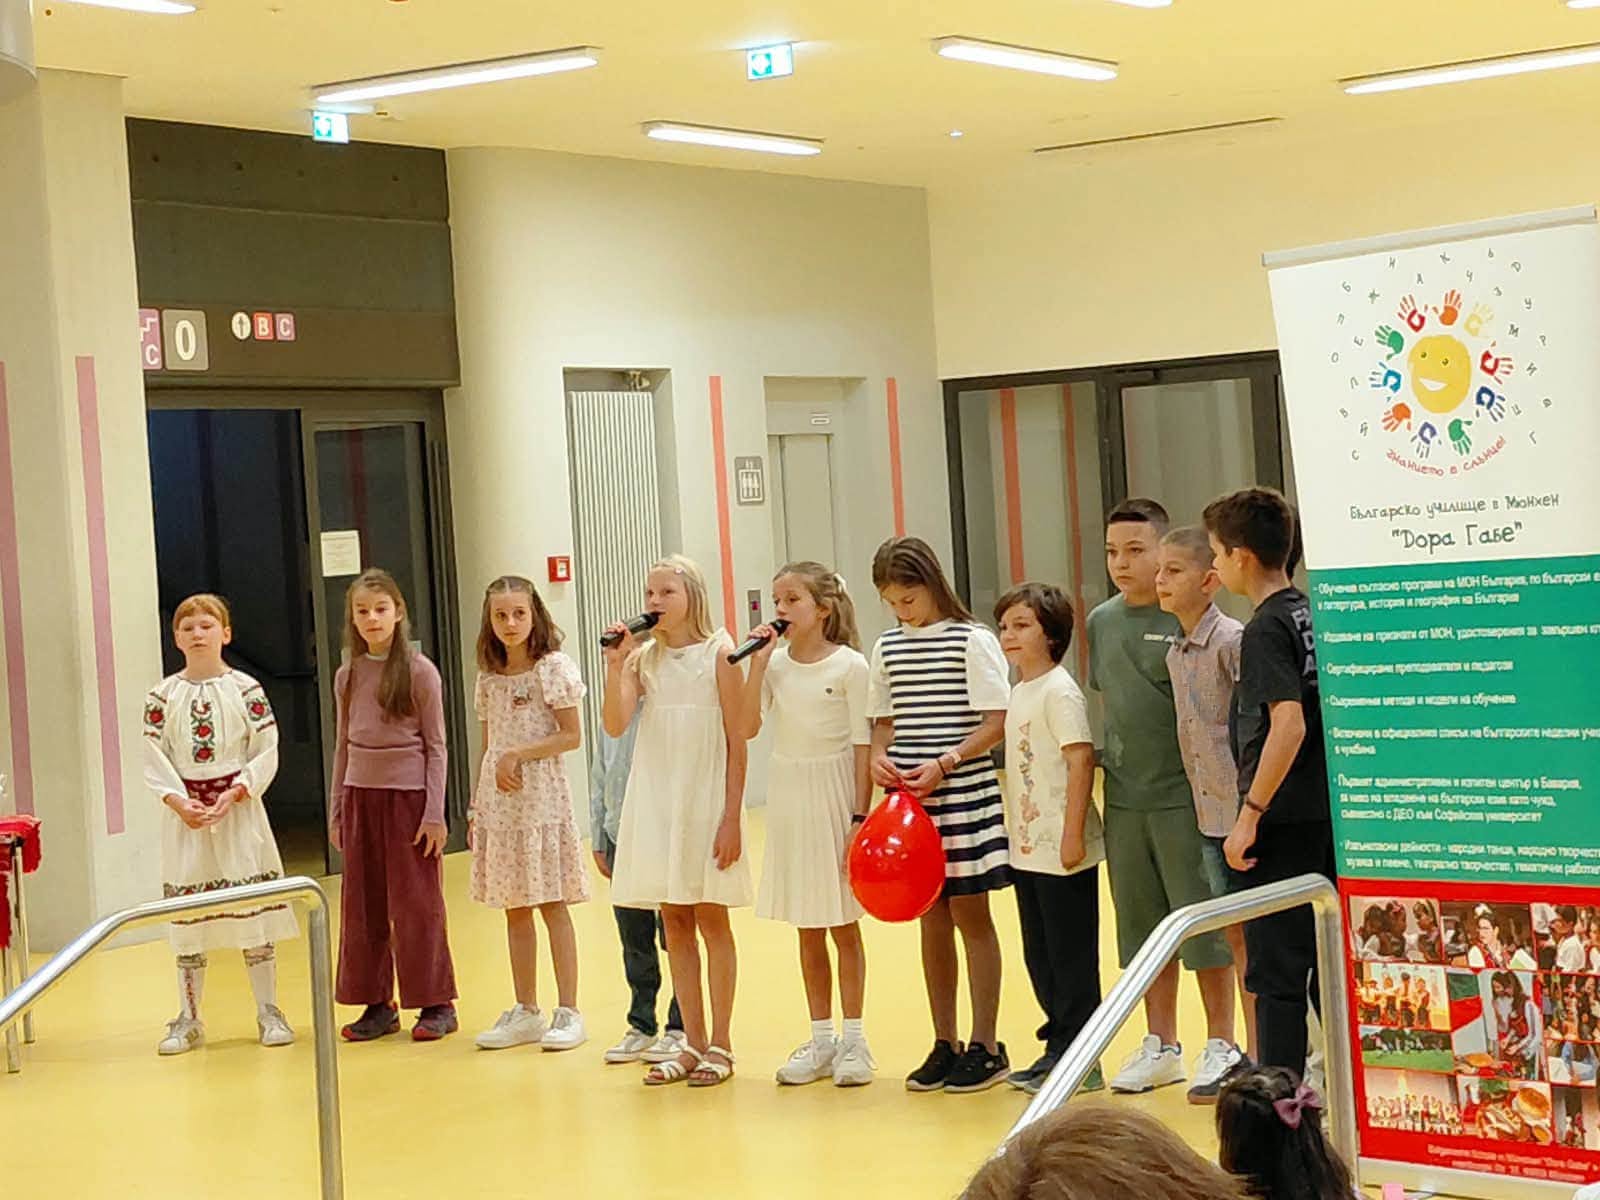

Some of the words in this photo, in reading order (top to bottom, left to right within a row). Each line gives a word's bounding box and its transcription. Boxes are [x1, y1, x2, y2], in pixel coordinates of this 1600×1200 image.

[258, 317, 269, 336] B
[279, 318, 290, 337] C
[1509, 324, 1519, 337] М
[145, 344, 159, 365] C
[1350, 504, 1421, 521] Българско
[1426, 498, 1486, 518] училище
[1505, 493, 1559, 510] Мюнхен
